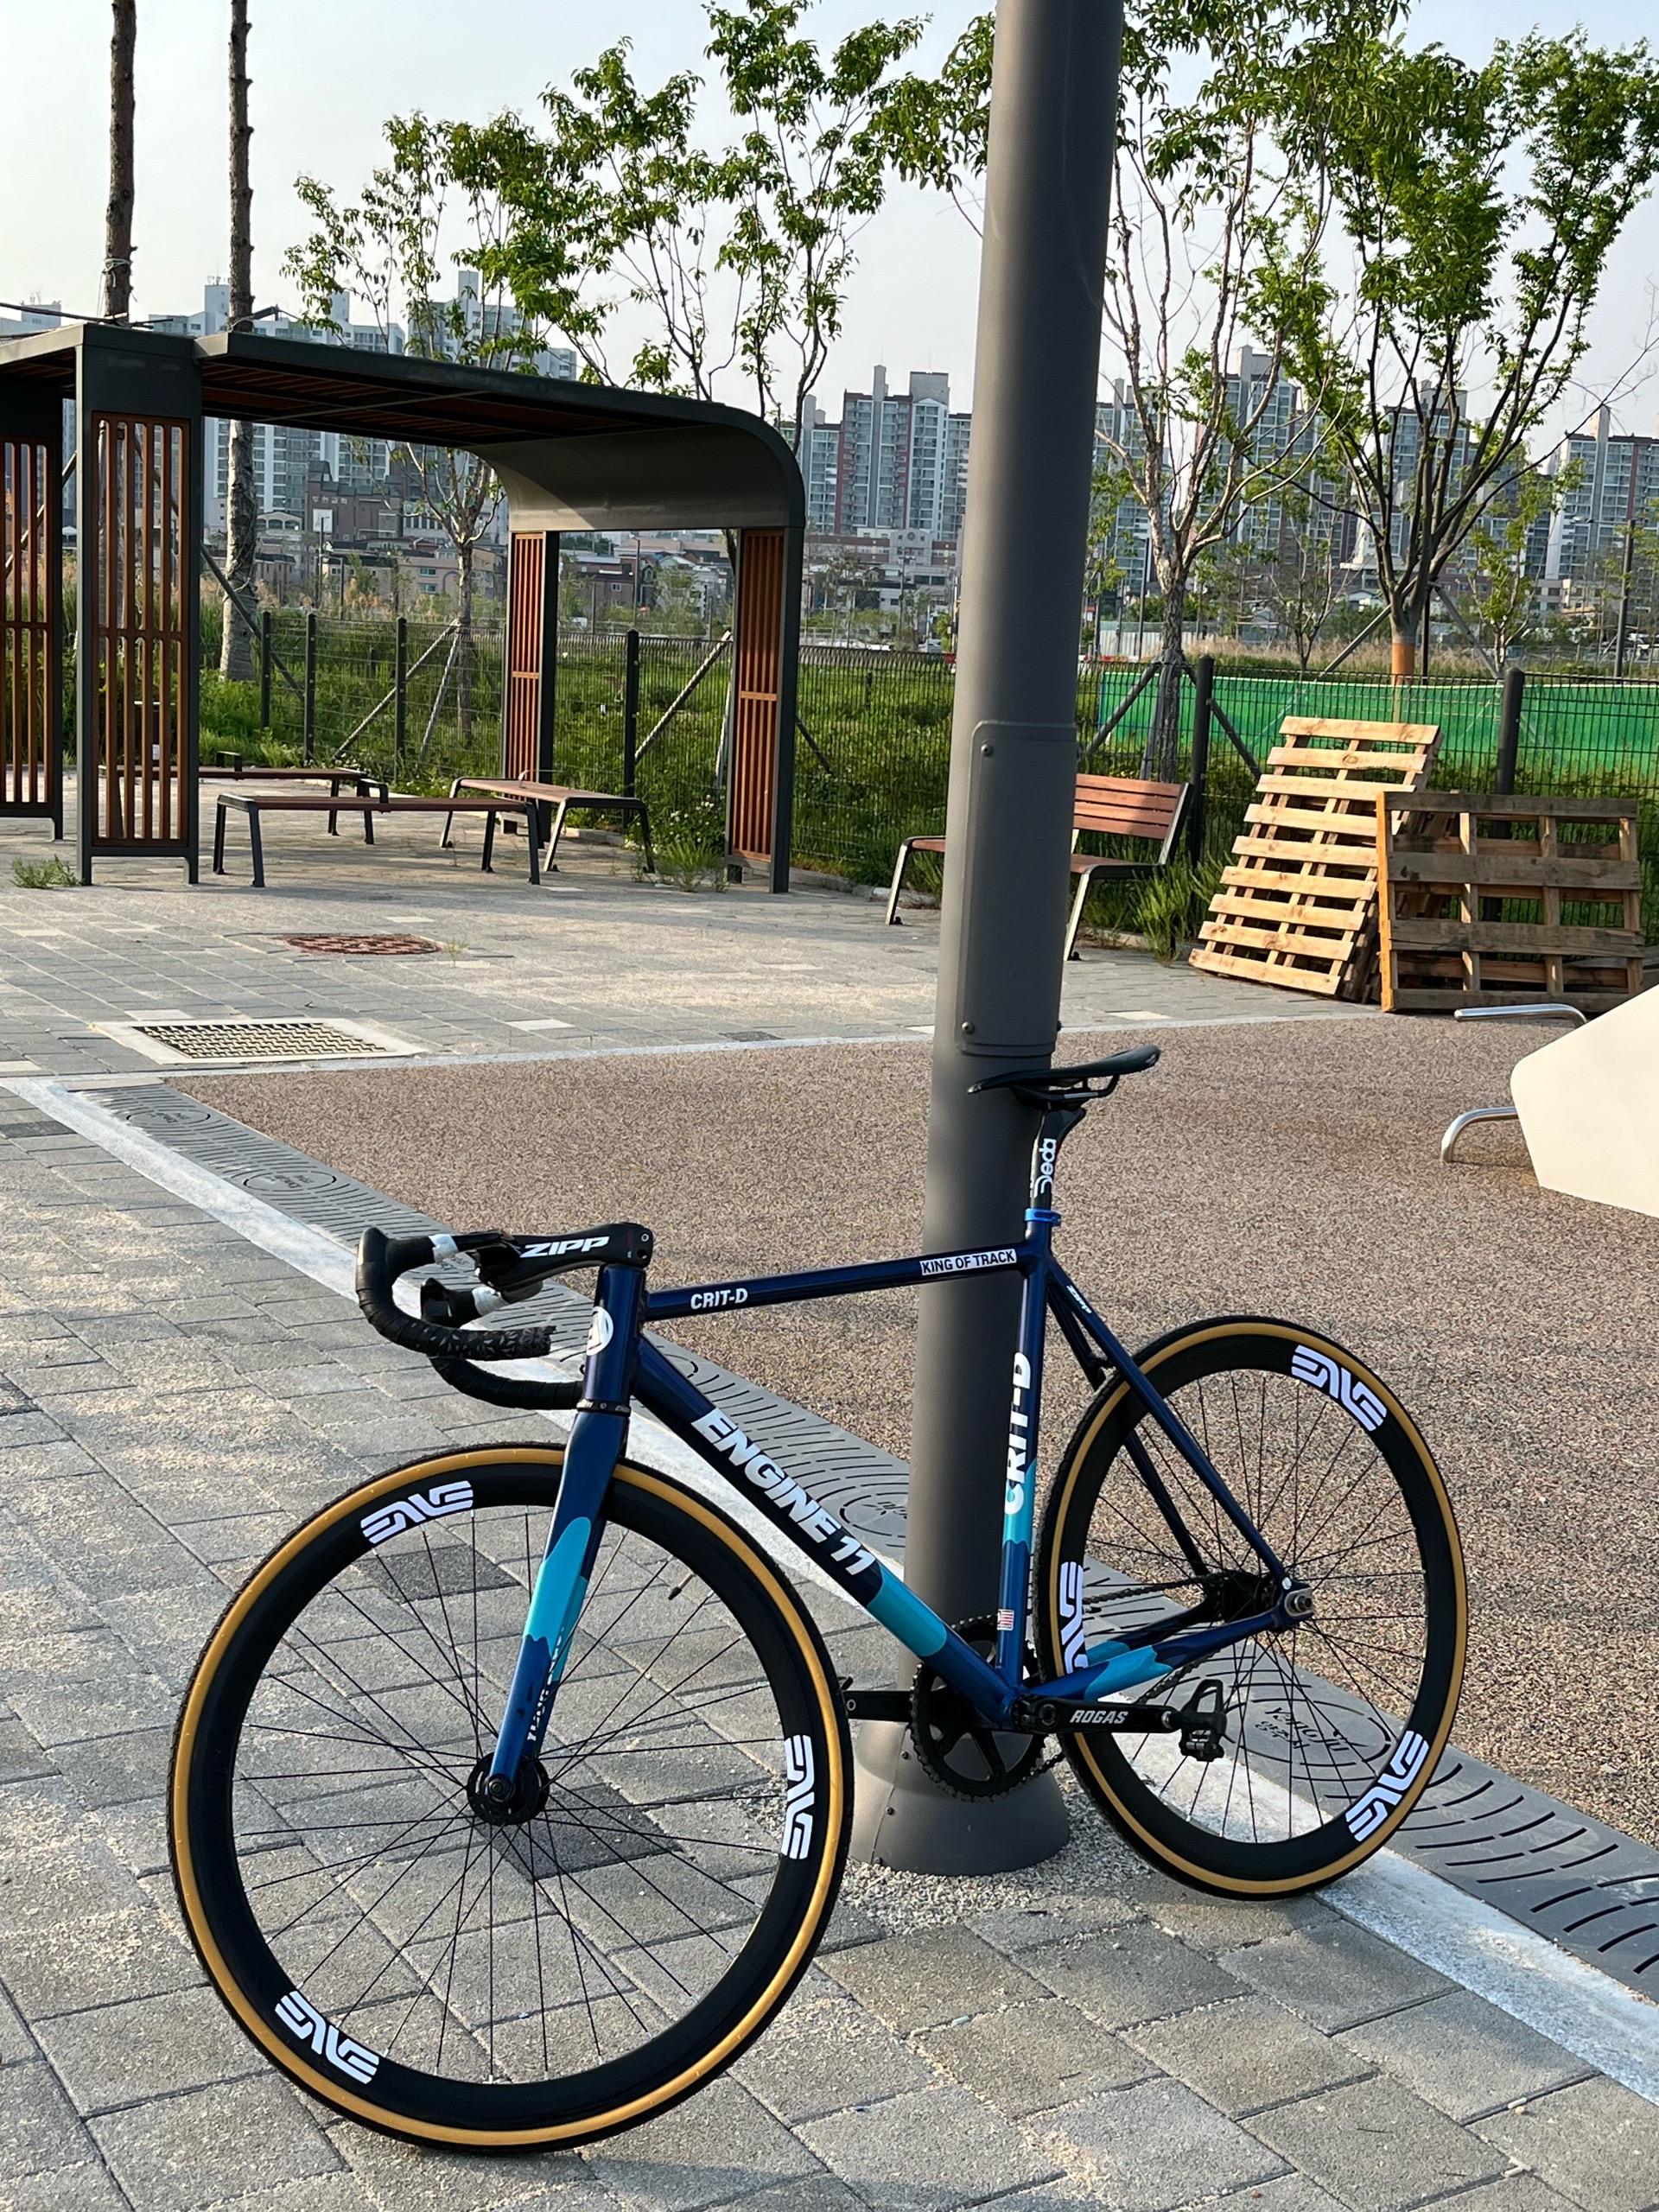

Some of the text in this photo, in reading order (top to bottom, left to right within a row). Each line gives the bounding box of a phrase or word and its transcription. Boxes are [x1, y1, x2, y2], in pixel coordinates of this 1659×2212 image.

[1032, 1138, 1057, 1198] Deda
[520, 1236, 610, 1259] ZIPP
[921, 1249, 1016, 1274] KING OF TRACK
[690, 1287, 748, 1310] CRIT-D
[1003, 1351, 1033, 1516] CRIT-D
